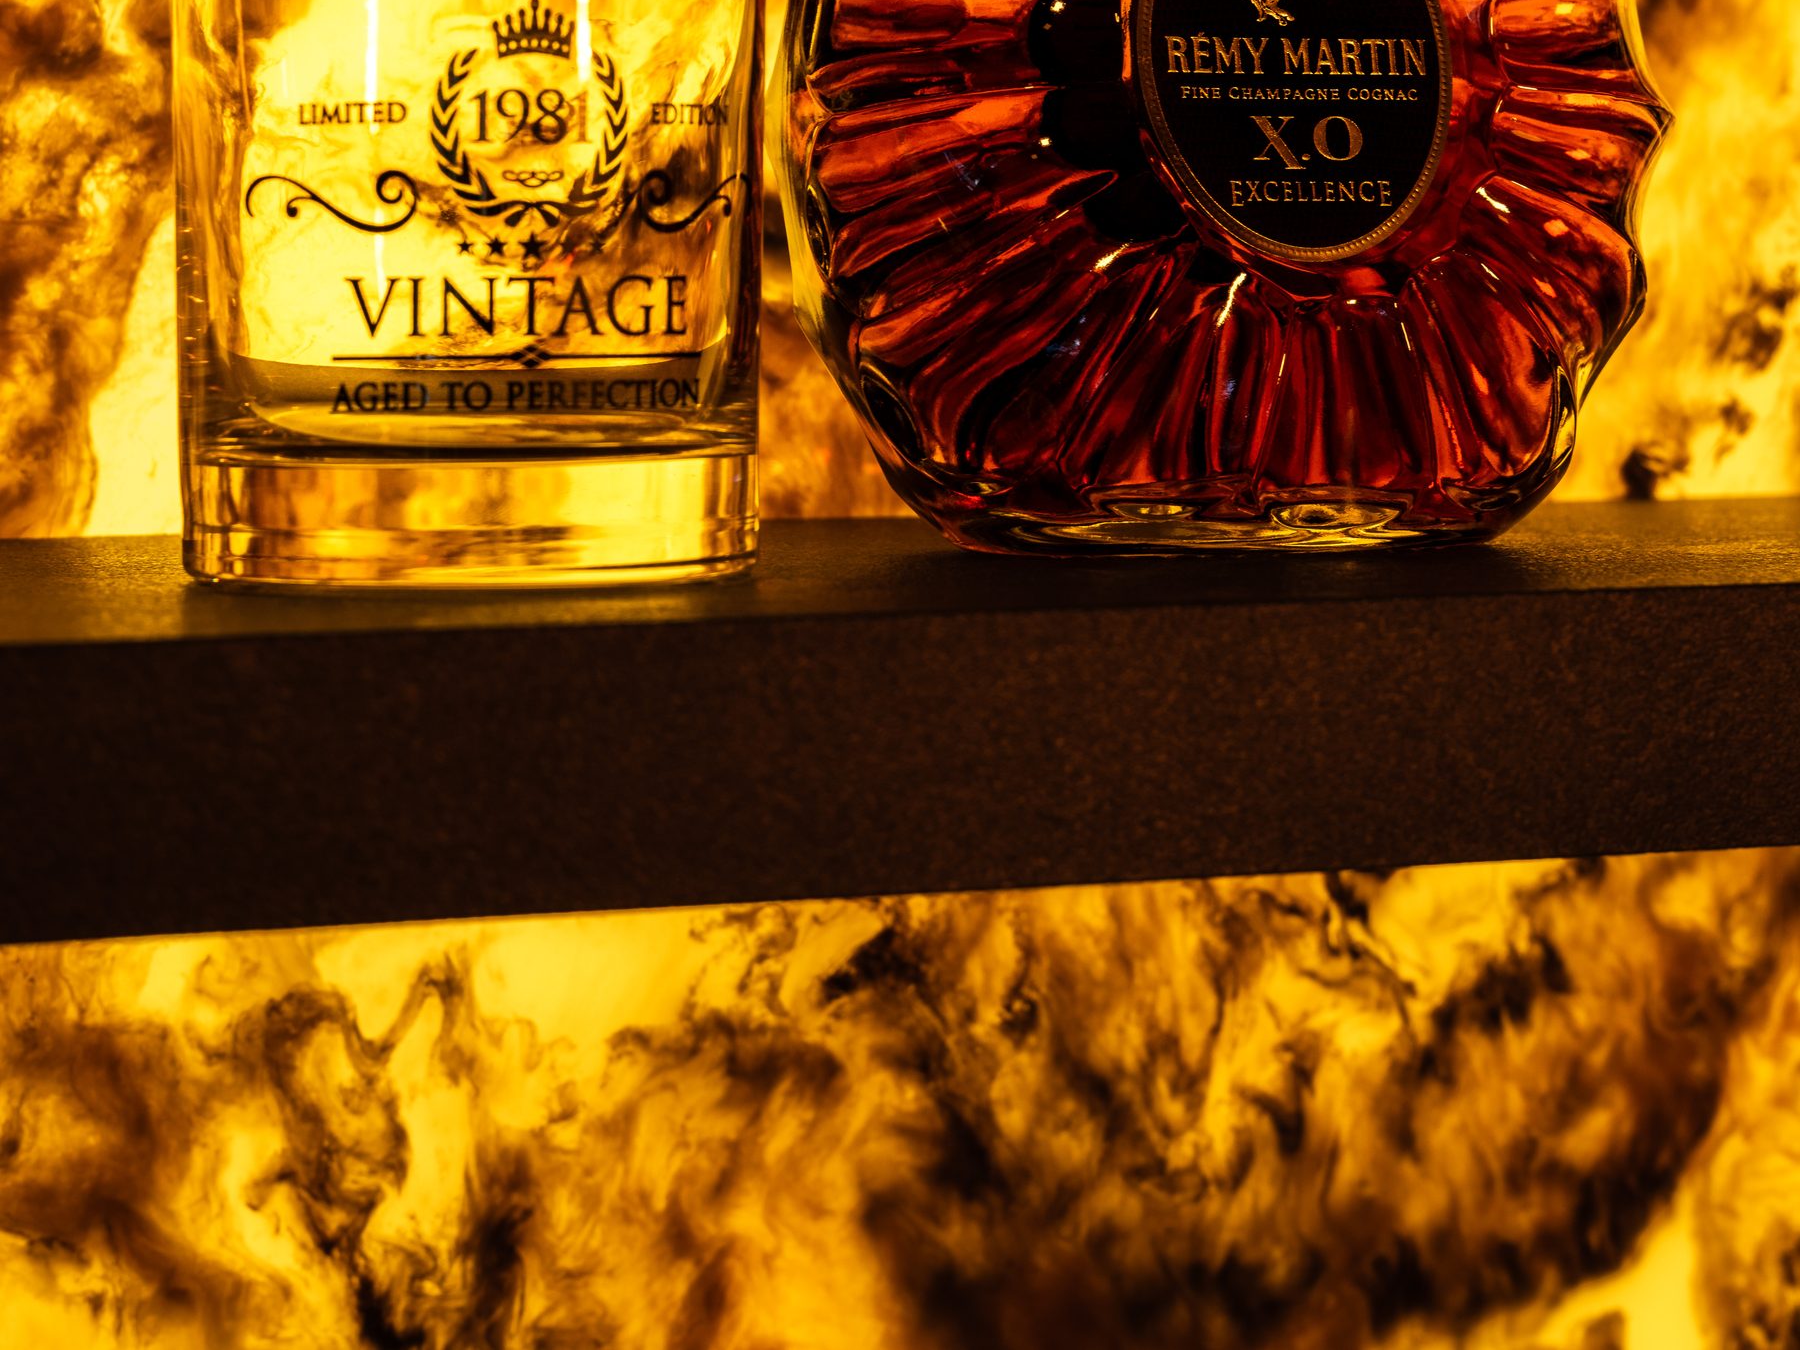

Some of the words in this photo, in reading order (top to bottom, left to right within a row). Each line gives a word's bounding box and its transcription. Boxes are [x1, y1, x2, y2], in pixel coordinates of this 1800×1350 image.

[1164, 32, 1269, 74] RÉMY
[1280, 37, 1427, 76] MARTIN
[1181, 85, 1221, 100] FINE
[1229, 86, 1340, 101] CHAMPAGNE
[1348, 87, 1419, 102] COGNAC
[298, 101, 407, 126] LIMITED
[470, 88, 594, 145] 1981
[650, 102, 729, 126] EDITION
[1249, 115, 1364, 170] X.O
[1229, 180, 1393, 207] EXCELLENCE
[344, 275, 689, 338] VINTAGE
[330, 381, 430, 414] AGED
[439, 381, 493, 411] TO
[506, 378, 700, 411] PERFECTION
